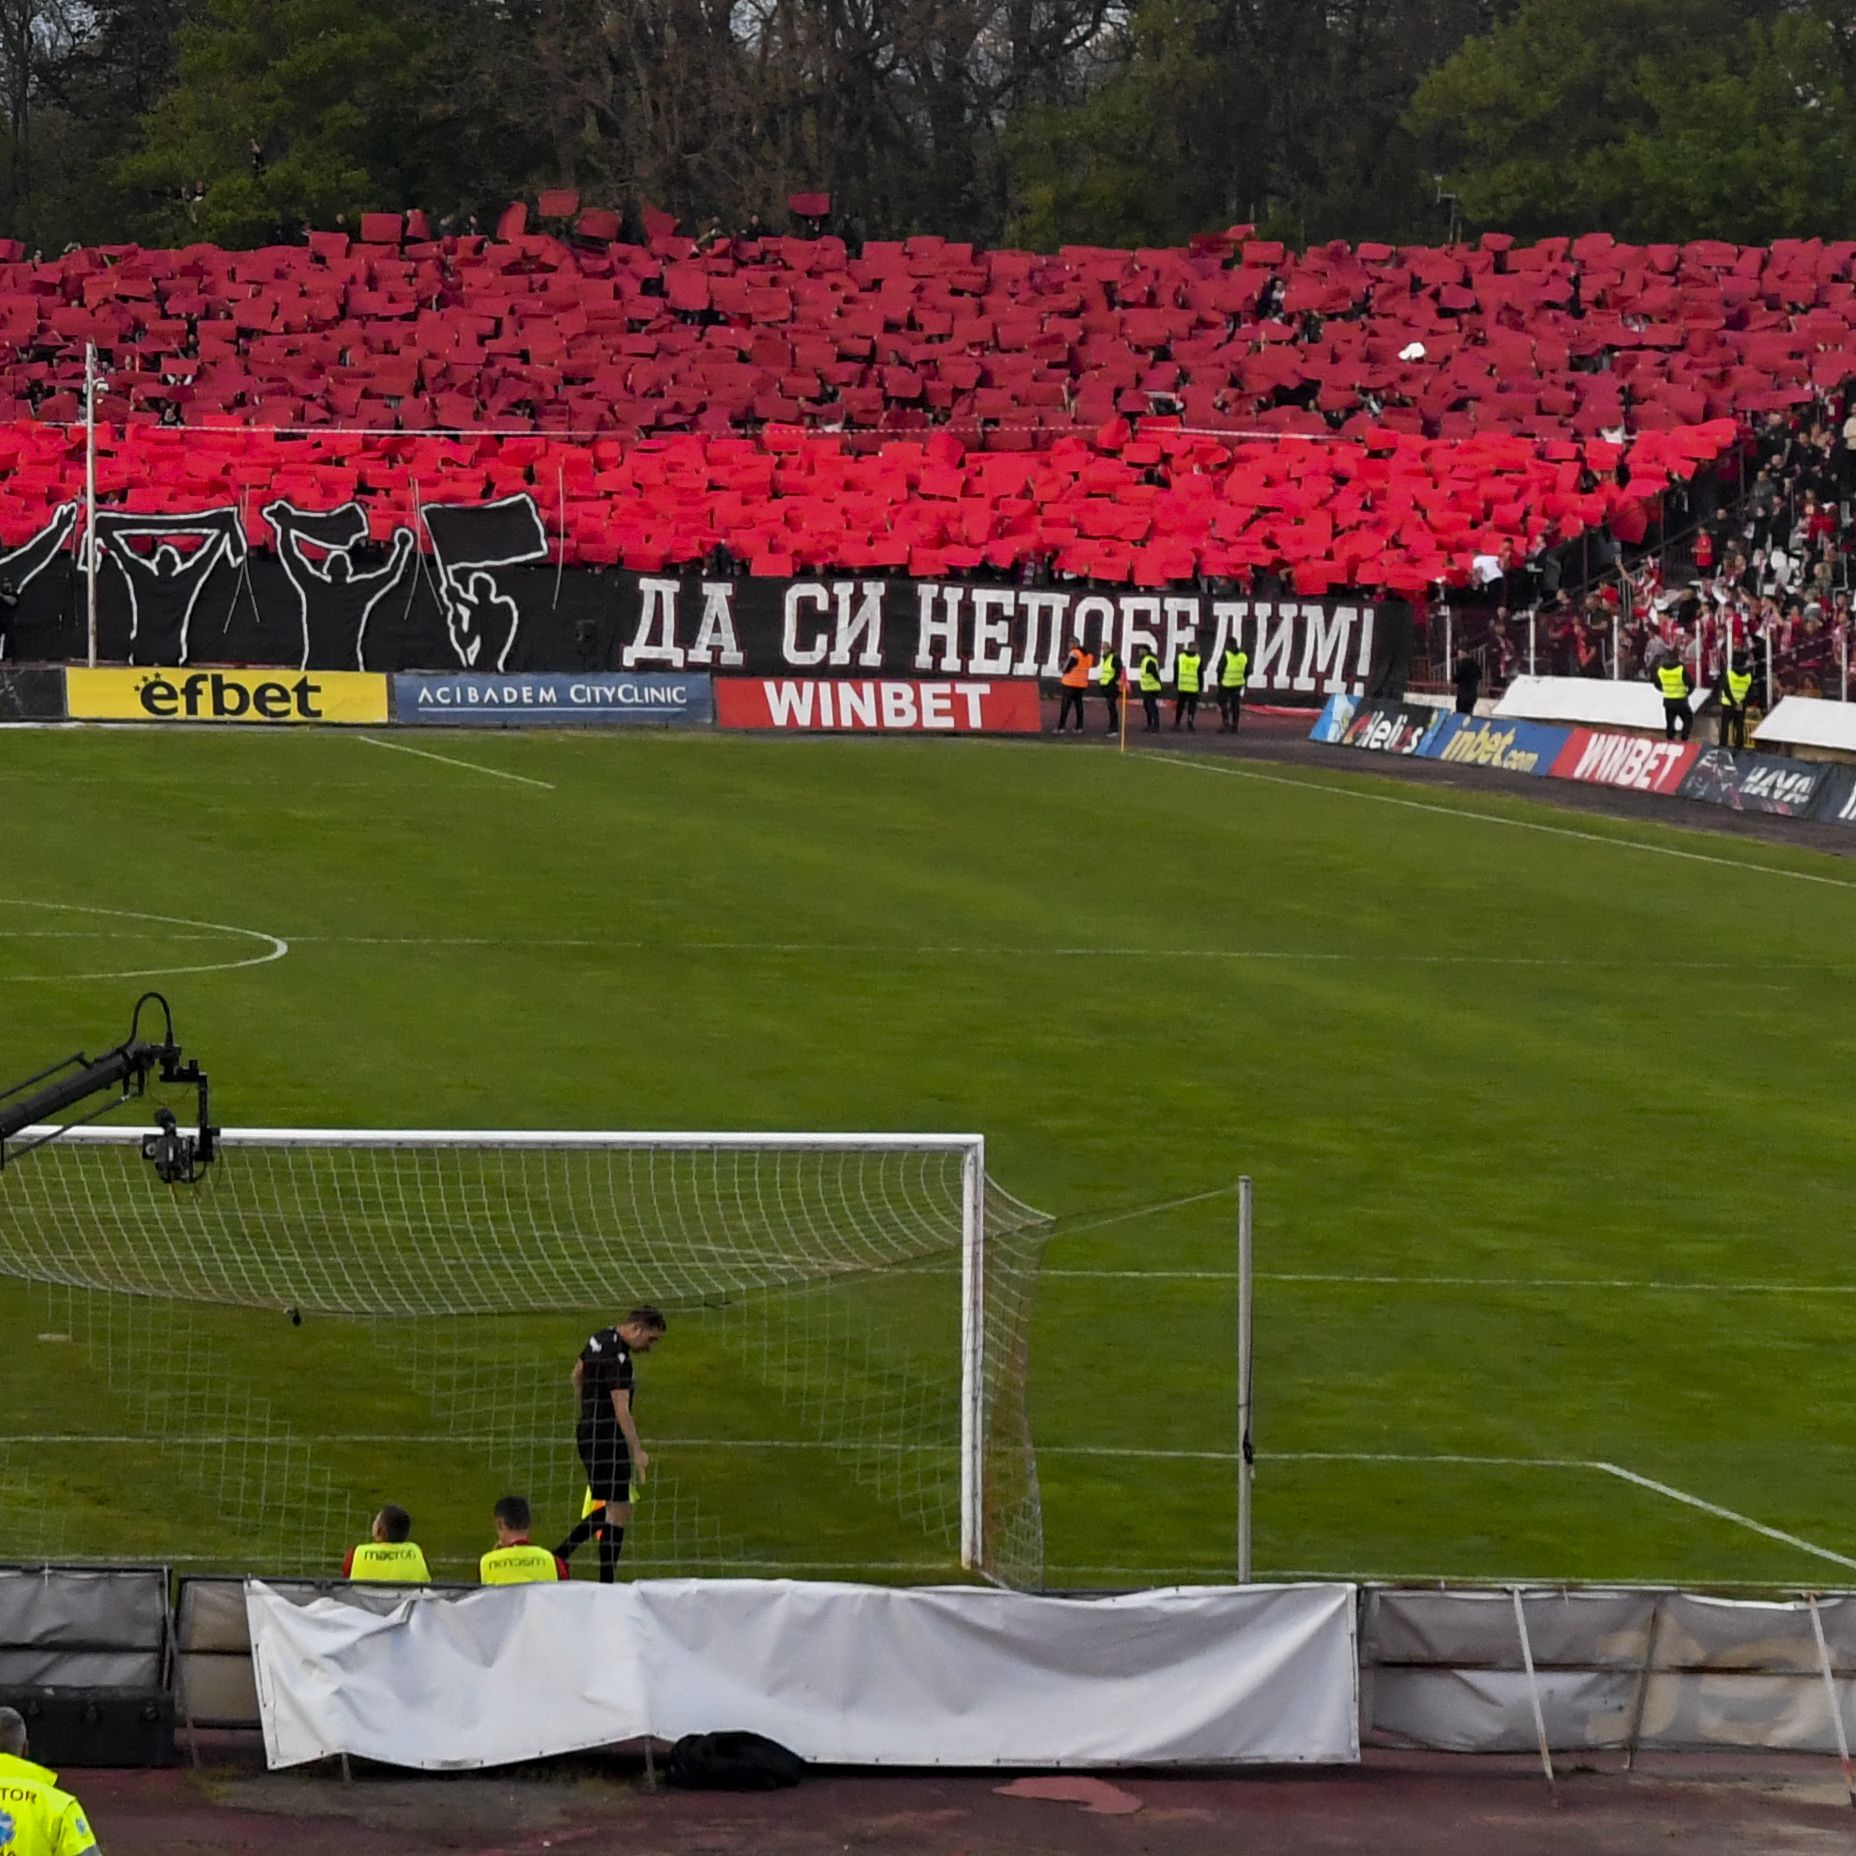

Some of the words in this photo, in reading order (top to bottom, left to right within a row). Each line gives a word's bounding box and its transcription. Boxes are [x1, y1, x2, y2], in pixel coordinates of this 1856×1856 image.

[622, 577, 744, 668] ДА
[781, 581, 886, 667] СИ
[914, 583, 1374, 697] НЕПОБЕДИМ!
[138, 673, 323, 719] efbet
[417, 686, 558, 705] ACIBADEM
[763, 680, 991, 729] WINBET
[1573, 732, 1685, 791] WINBET
[363, 1549, 417, 1562] macron
